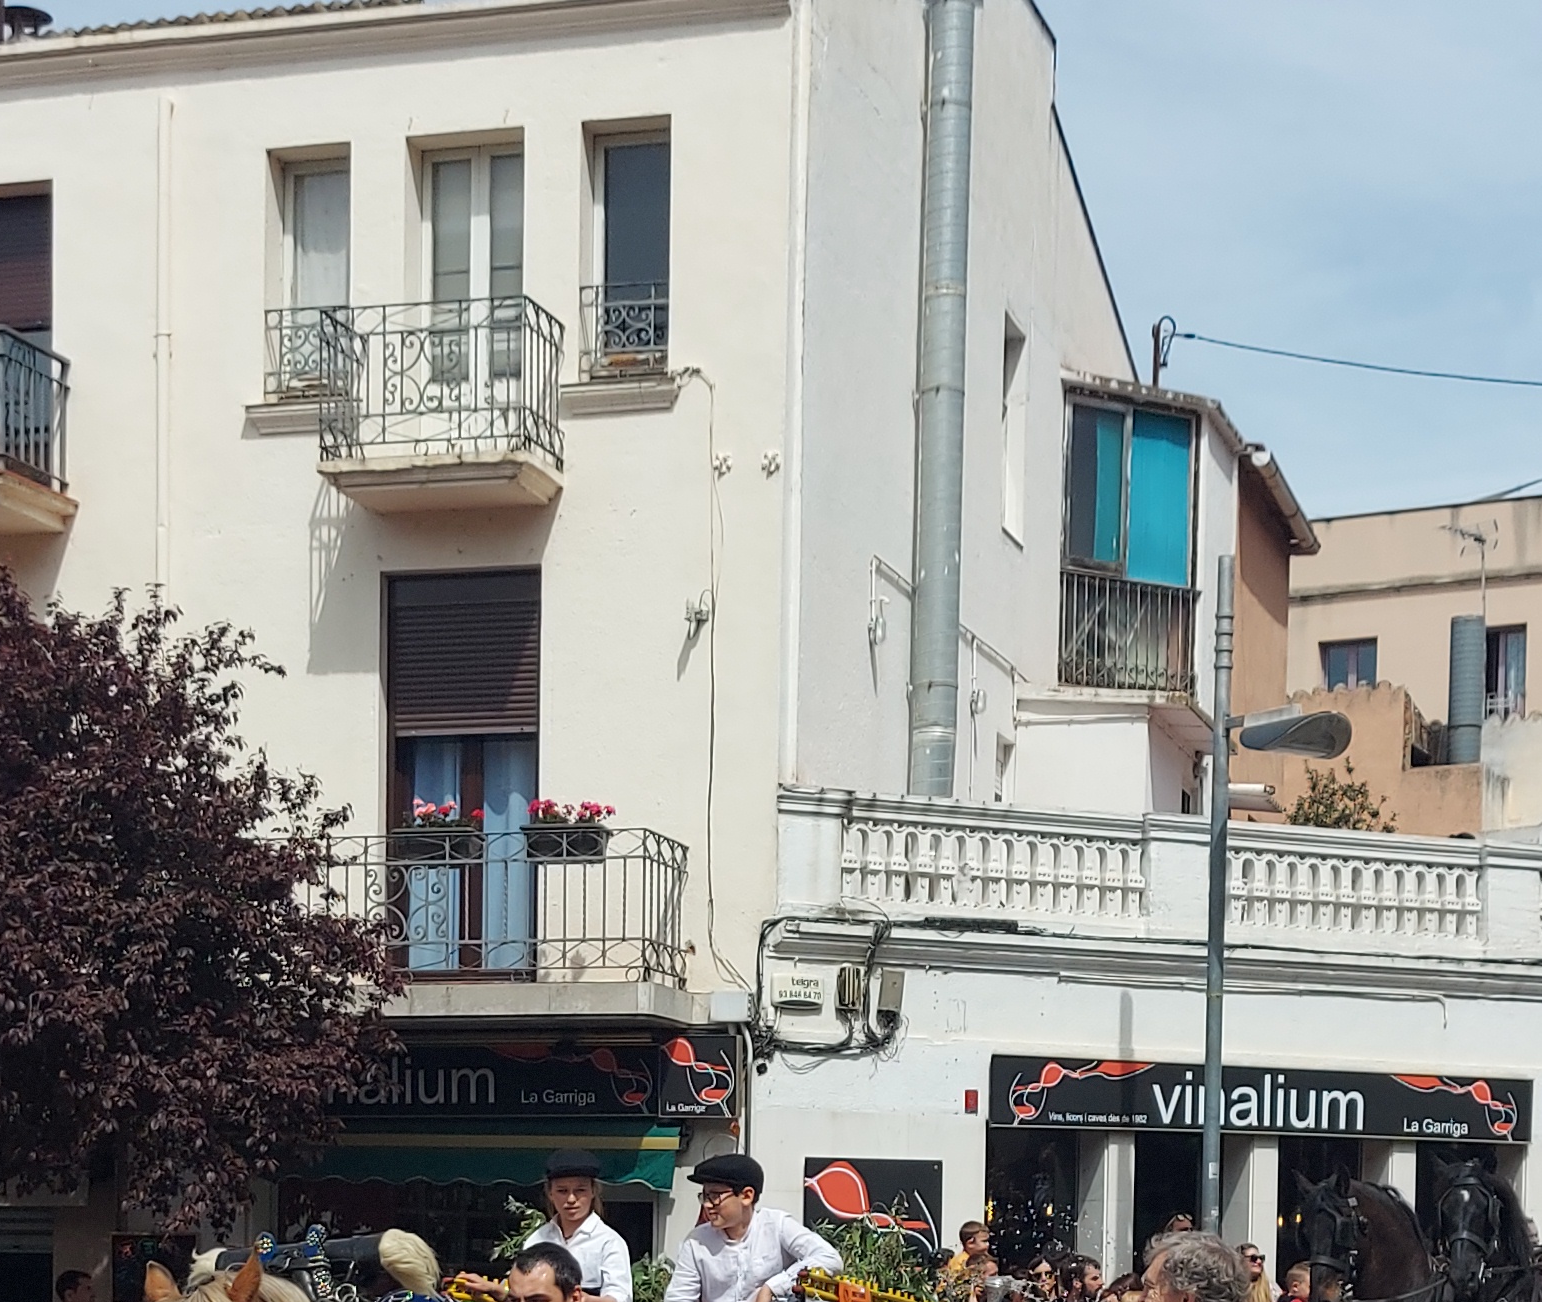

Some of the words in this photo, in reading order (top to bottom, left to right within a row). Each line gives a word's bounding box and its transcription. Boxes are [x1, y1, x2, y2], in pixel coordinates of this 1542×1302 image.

[520, 1089, 537, 1104] La
[542, 1089, 596, 1106] Garriga
[1151, 1070, 1365, 1131] vinalium
[665, 1101, 677, 1112] La
[677, 1102, 708, 1114] Garriga
[1403, 1117, 1419, 1133] La
[1422, 1118, 1469, 1138] Garriga
